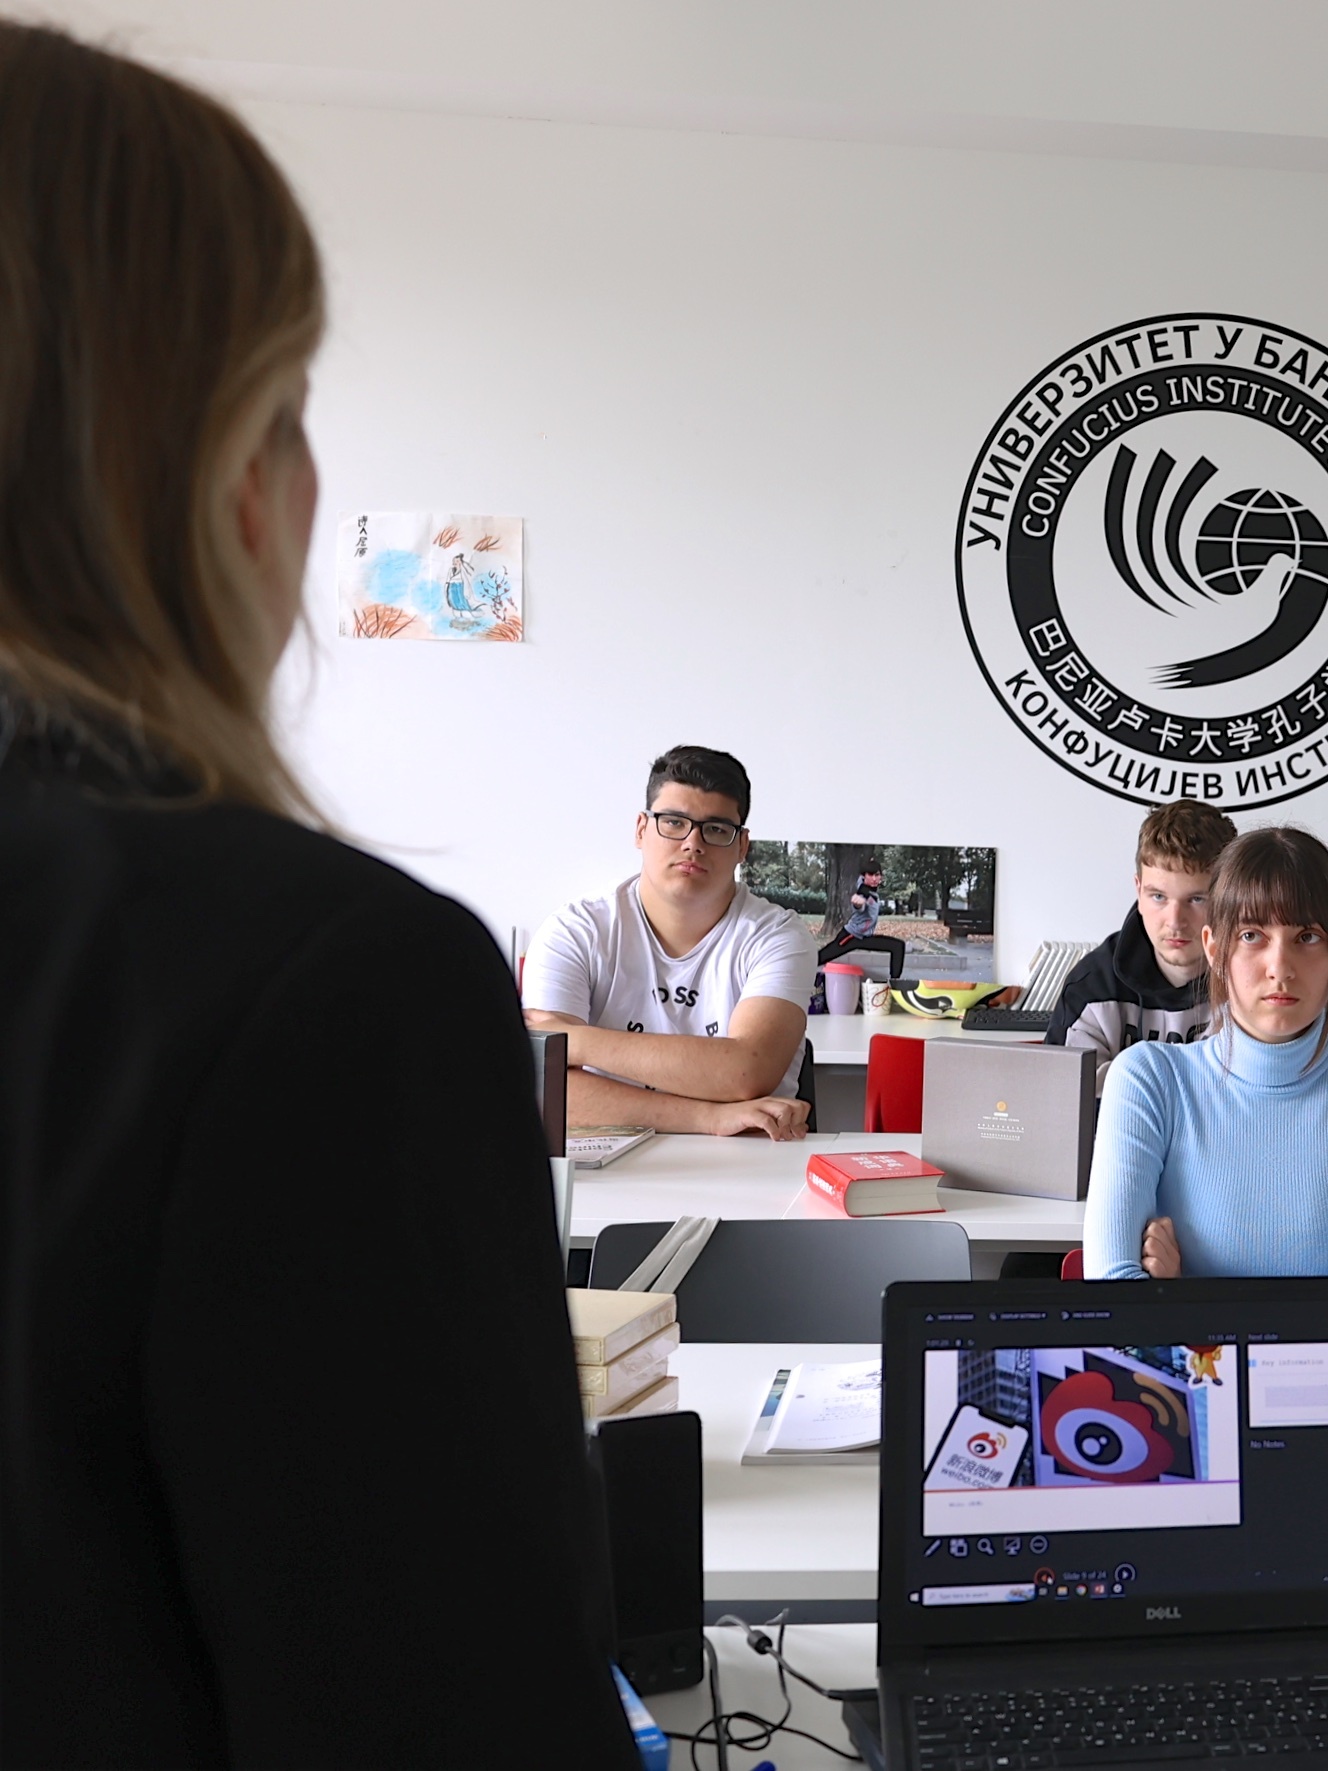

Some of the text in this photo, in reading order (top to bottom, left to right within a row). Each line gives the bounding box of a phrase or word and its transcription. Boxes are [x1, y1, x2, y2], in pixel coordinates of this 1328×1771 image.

[967, 325, 1200, 551] УНИВЕРЗИТЕТ
[1214, 326, 1244, 360] У
[1021, 384, 1159, 538] CONFUCIUS
[1004, 669, 1224, 800] КОНФУЦИЈЕВ
[1261, 1358, 1325, 1368] Key information
[1250, 1440, 1285, 1449] No Notes
[1146, 1607, 1181, 1620] DELL
